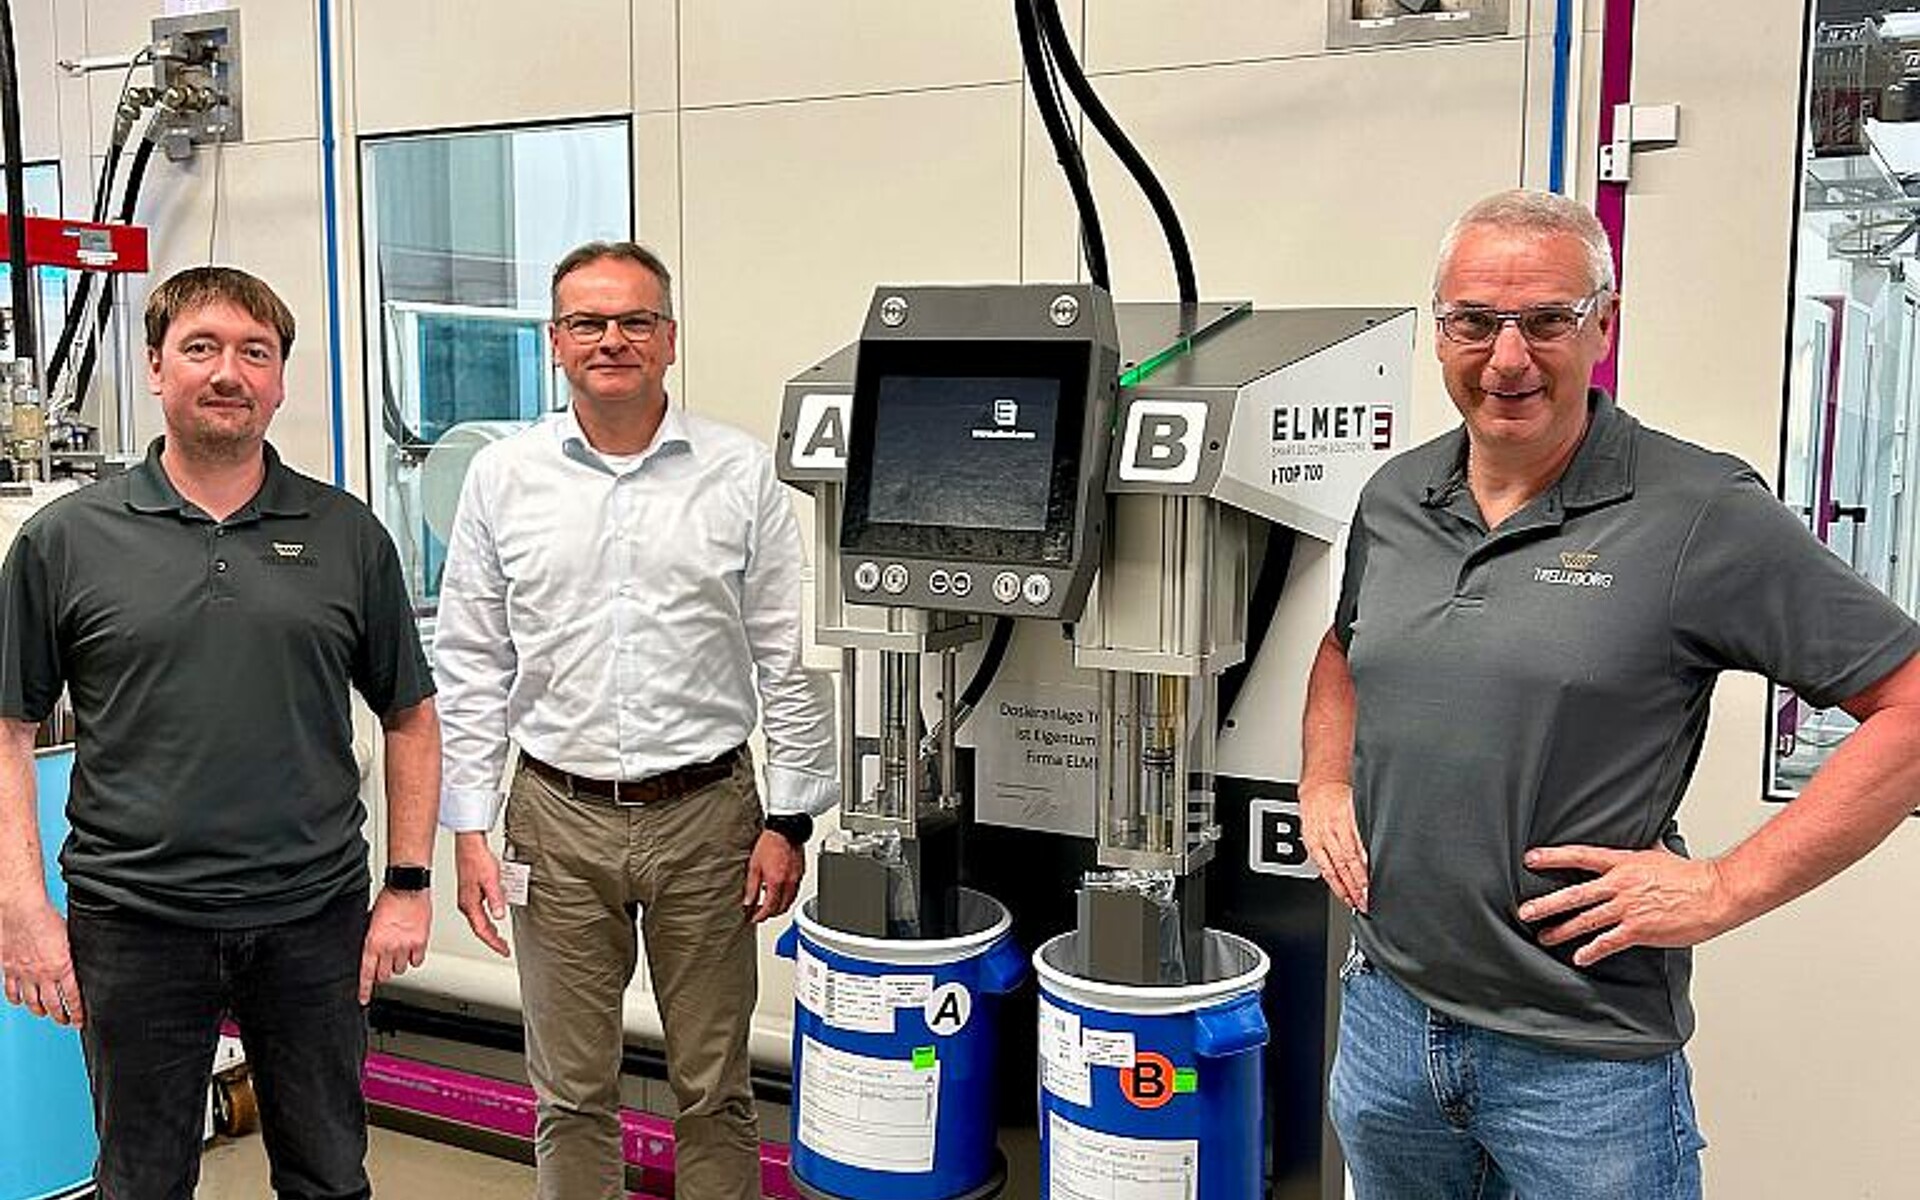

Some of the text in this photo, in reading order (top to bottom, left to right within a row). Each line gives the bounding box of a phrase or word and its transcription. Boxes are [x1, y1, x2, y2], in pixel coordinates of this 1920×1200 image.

[802, 406, 848, 458] A
[1271, 405, 1366, 441] ELMET
[1132, 413, 1188, 470] B
[1304, 463, 1324, 481] 700
[999, 702, 1084, 725] Dosieranlage
[1033, 729, 1096, 747] Eigentum
[1026, 749, 1099, 770] Firma ELM
[1262, 811, 1308, 865] B
[931, 992, 961, 1026] A
[1132, 1062, 1166, 1098] B
